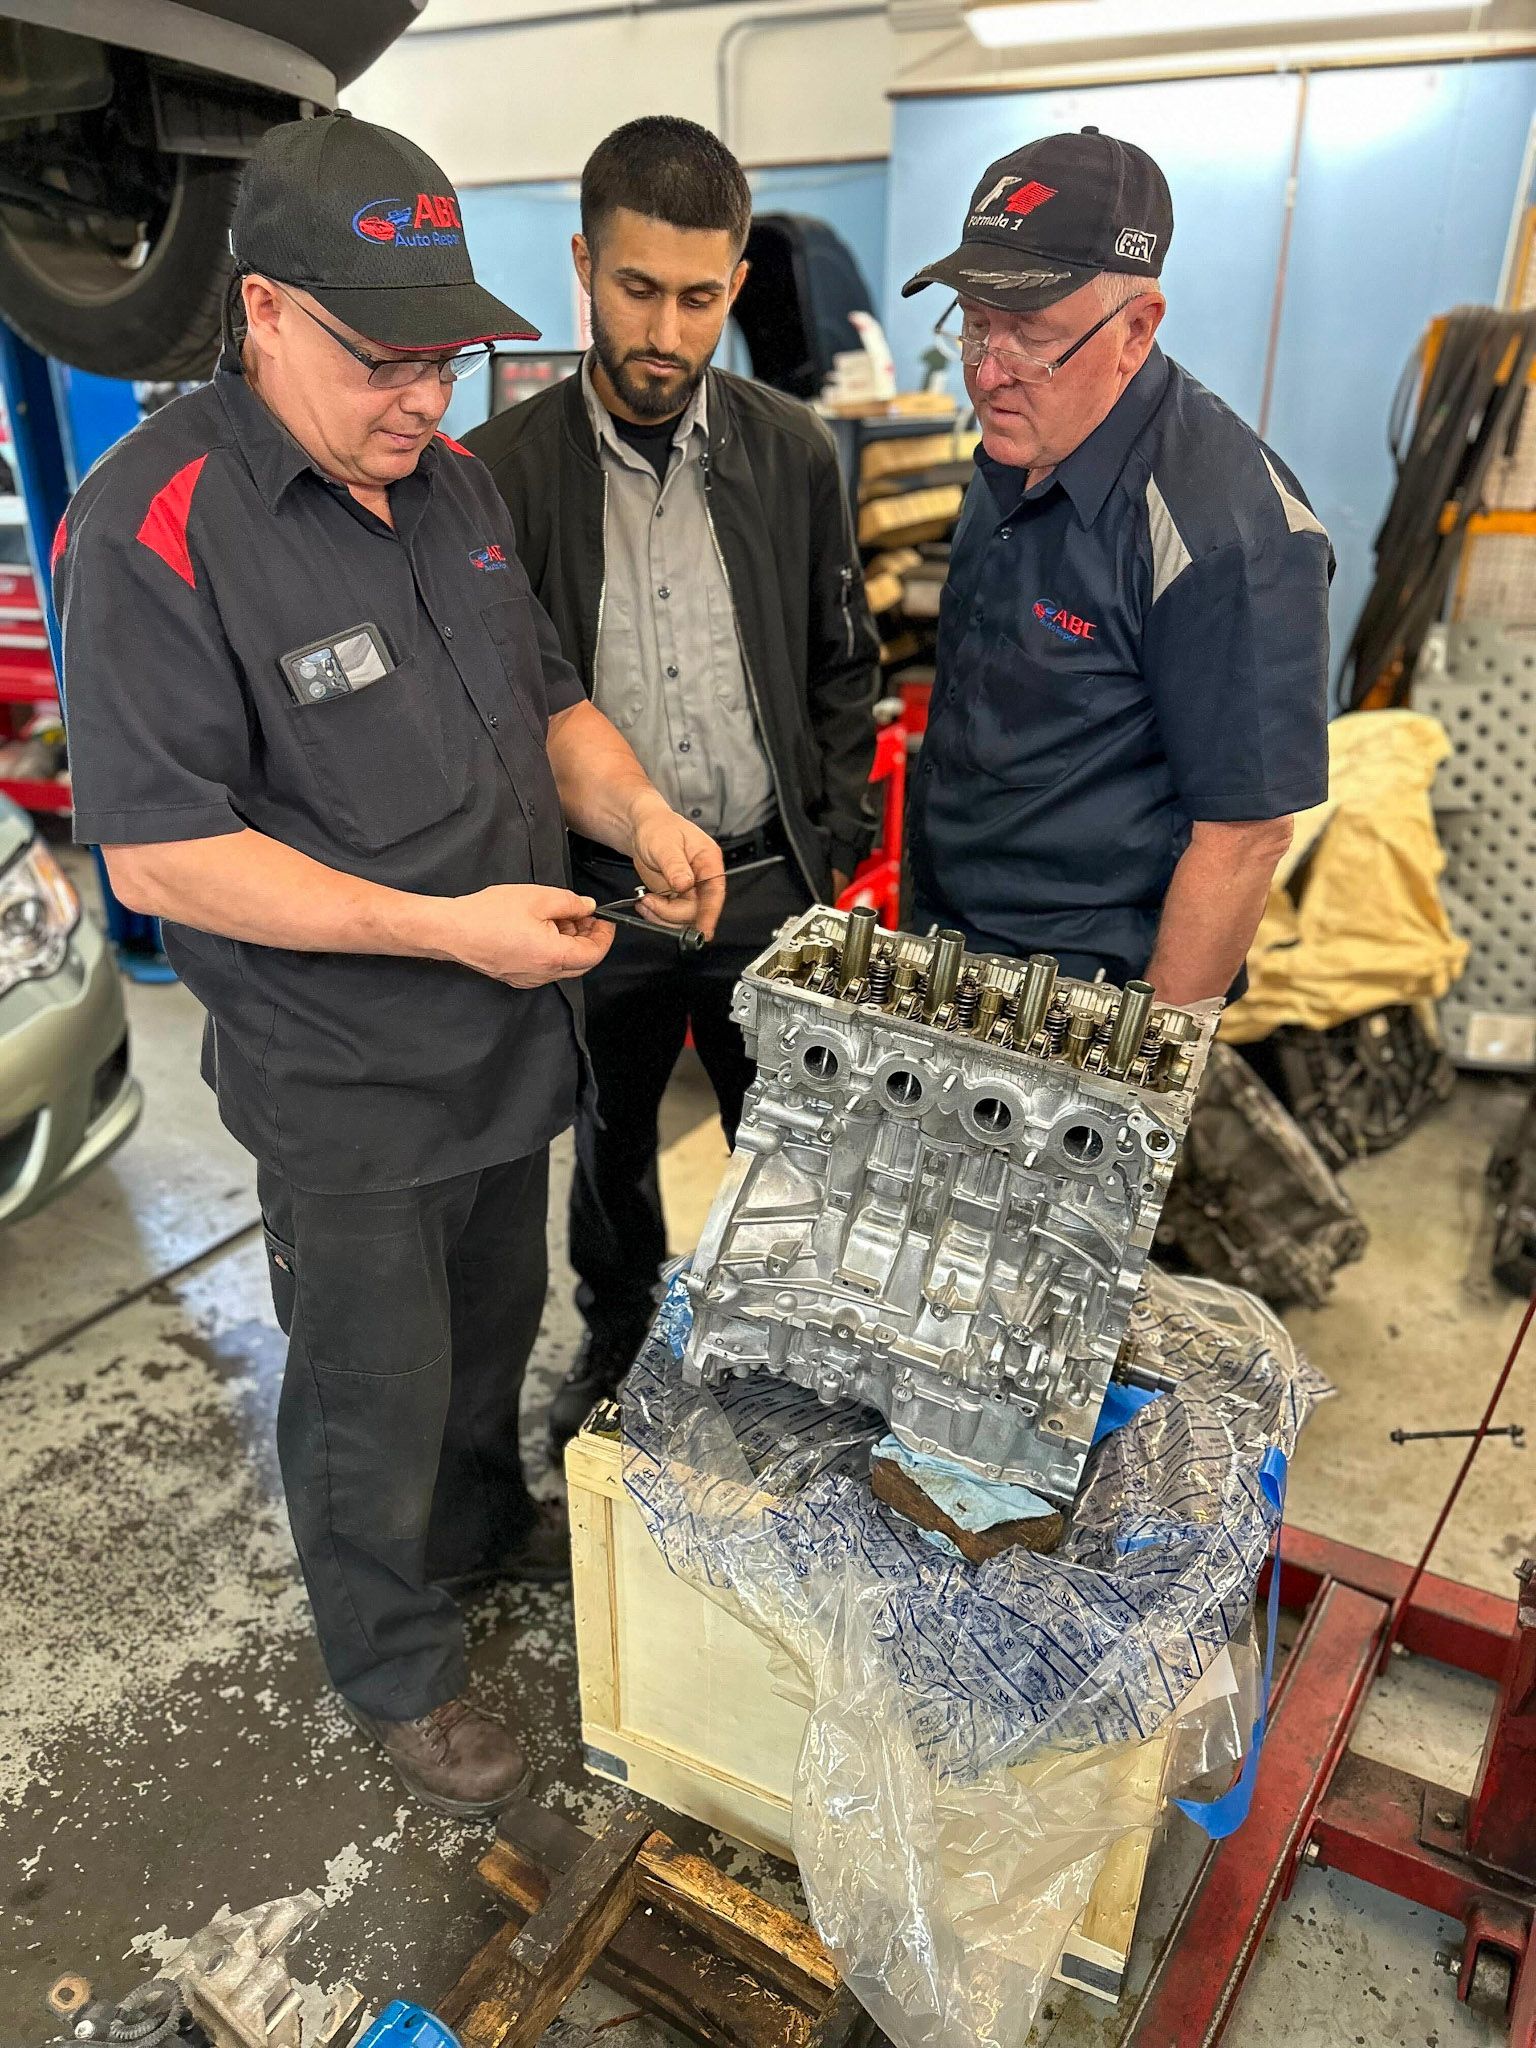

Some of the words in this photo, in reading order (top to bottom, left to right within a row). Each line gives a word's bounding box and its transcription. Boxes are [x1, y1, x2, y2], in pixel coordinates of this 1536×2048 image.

[968, 213, 1010, 228] Formula
[1010, 218, 1024, 231] 1
[395, 233, 431, 247] Auto
[1052, 609, 1098, 641] ABC
